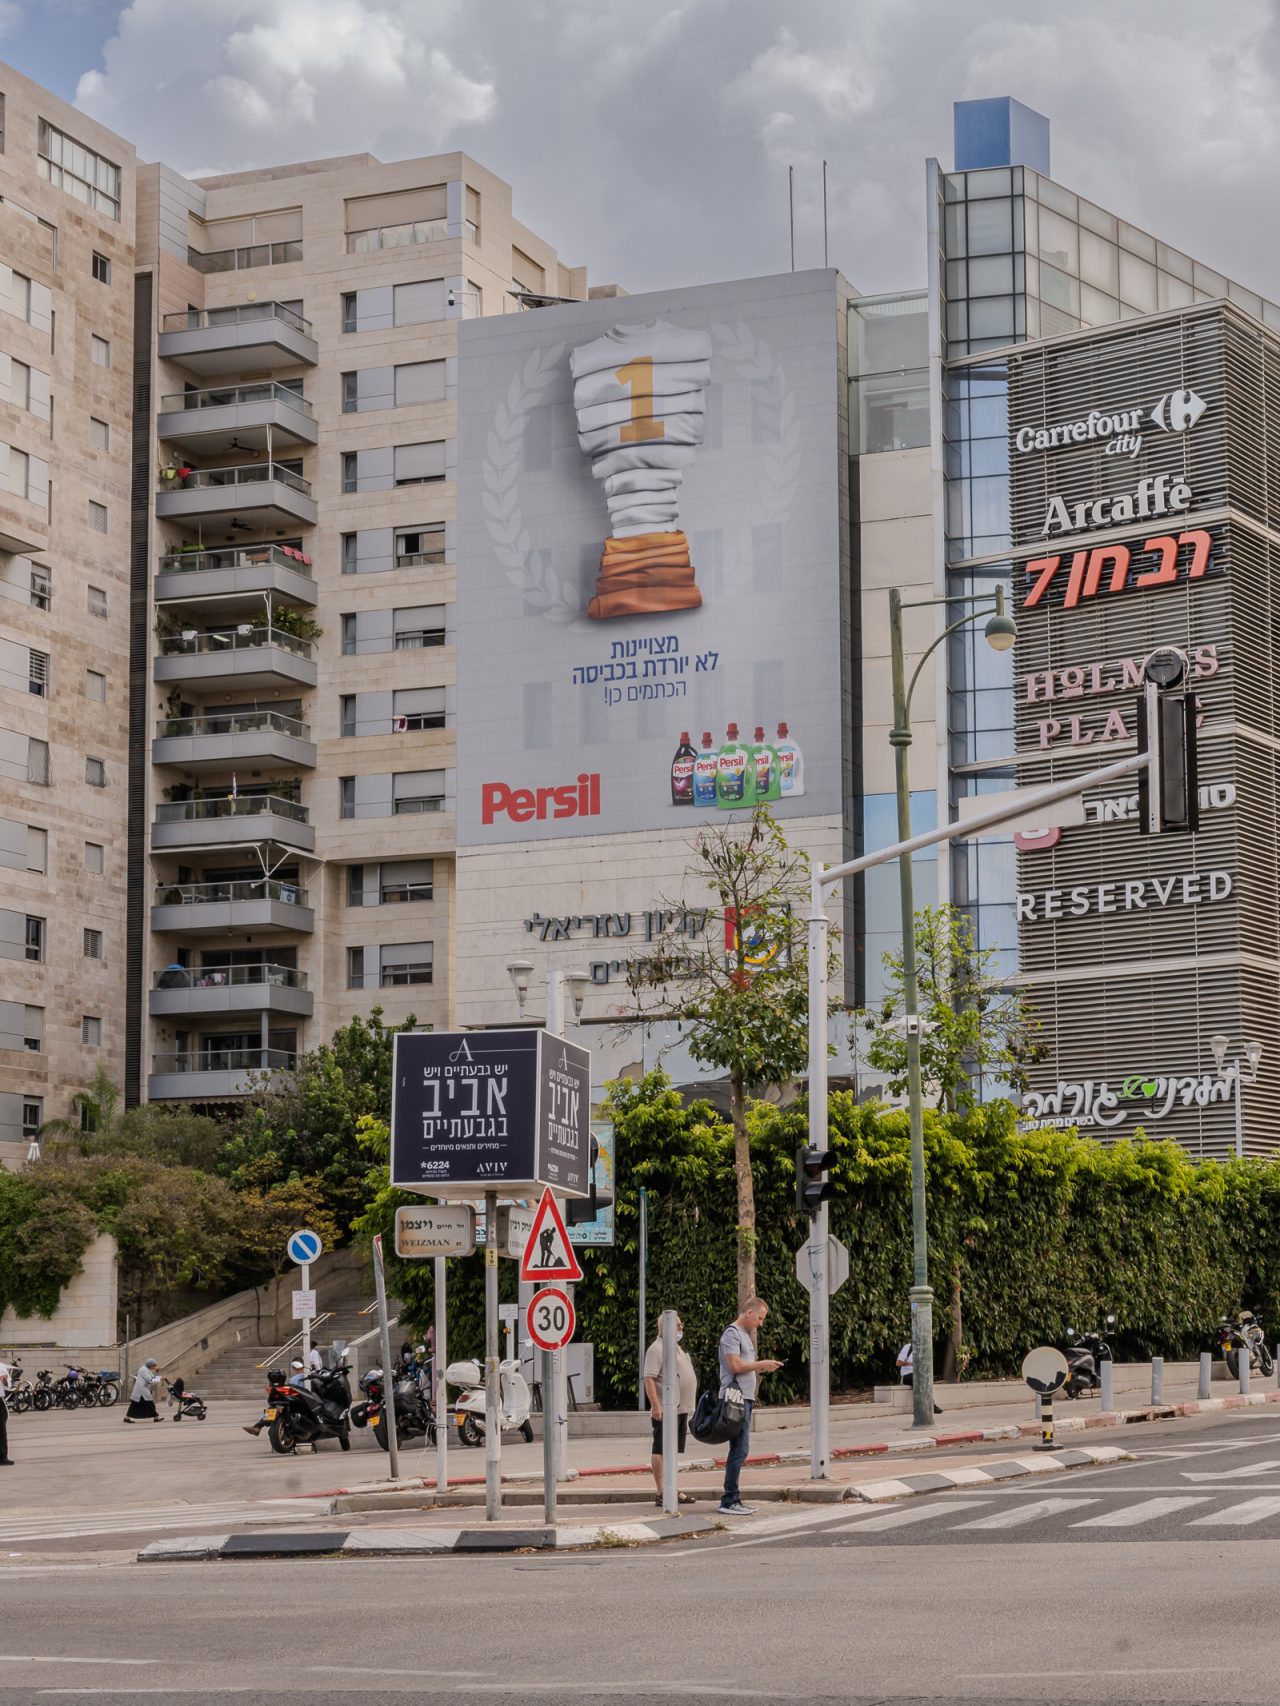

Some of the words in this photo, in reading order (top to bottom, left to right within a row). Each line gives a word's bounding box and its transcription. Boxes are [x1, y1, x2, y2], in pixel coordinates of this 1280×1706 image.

[615, 356, 664, 443] 1
[1016, 407, 1144, 453] Carrefour
[1105, 434, 1143, 459] city
[1137, 530, 1212, 587] רב
[611, 636, 679, 659] מצויינות
[573, 661, 638, 684] בכביסה
[643, 656, 689, 677] יורדת
[695, 651, 719, 672] לא
[1025, 645, 1218, 703] HOLMS
[604, 686, 621, 707] כן!
[628, 681, 686, 701] הכתמים
[720, 756, 744, 767] Persil
[778, 752, 794, 762] ersil
[482, 773, 600, 825] Persil
[1016, 872, 1232, 921] RESERVED
[523, 912, 630, 941] עזריאלי
[643, 907, 708, 941] קניון
[424, 1067, 440, 1077] ויש
[445, 1065, 490, 1077] גבעתיים
[495, 1064, 508, 1075] יש
[422, 1077, 508, 1117] אביב
[548, 1081, 579, 1128] אביב
[423, 1117, 508, 1138] בגבעתיים
[477, 1162, 508, 1172] AVIV
[400, 1219, 433, 1232] ויצמן
[538, 1306, 565, 1331] 30
